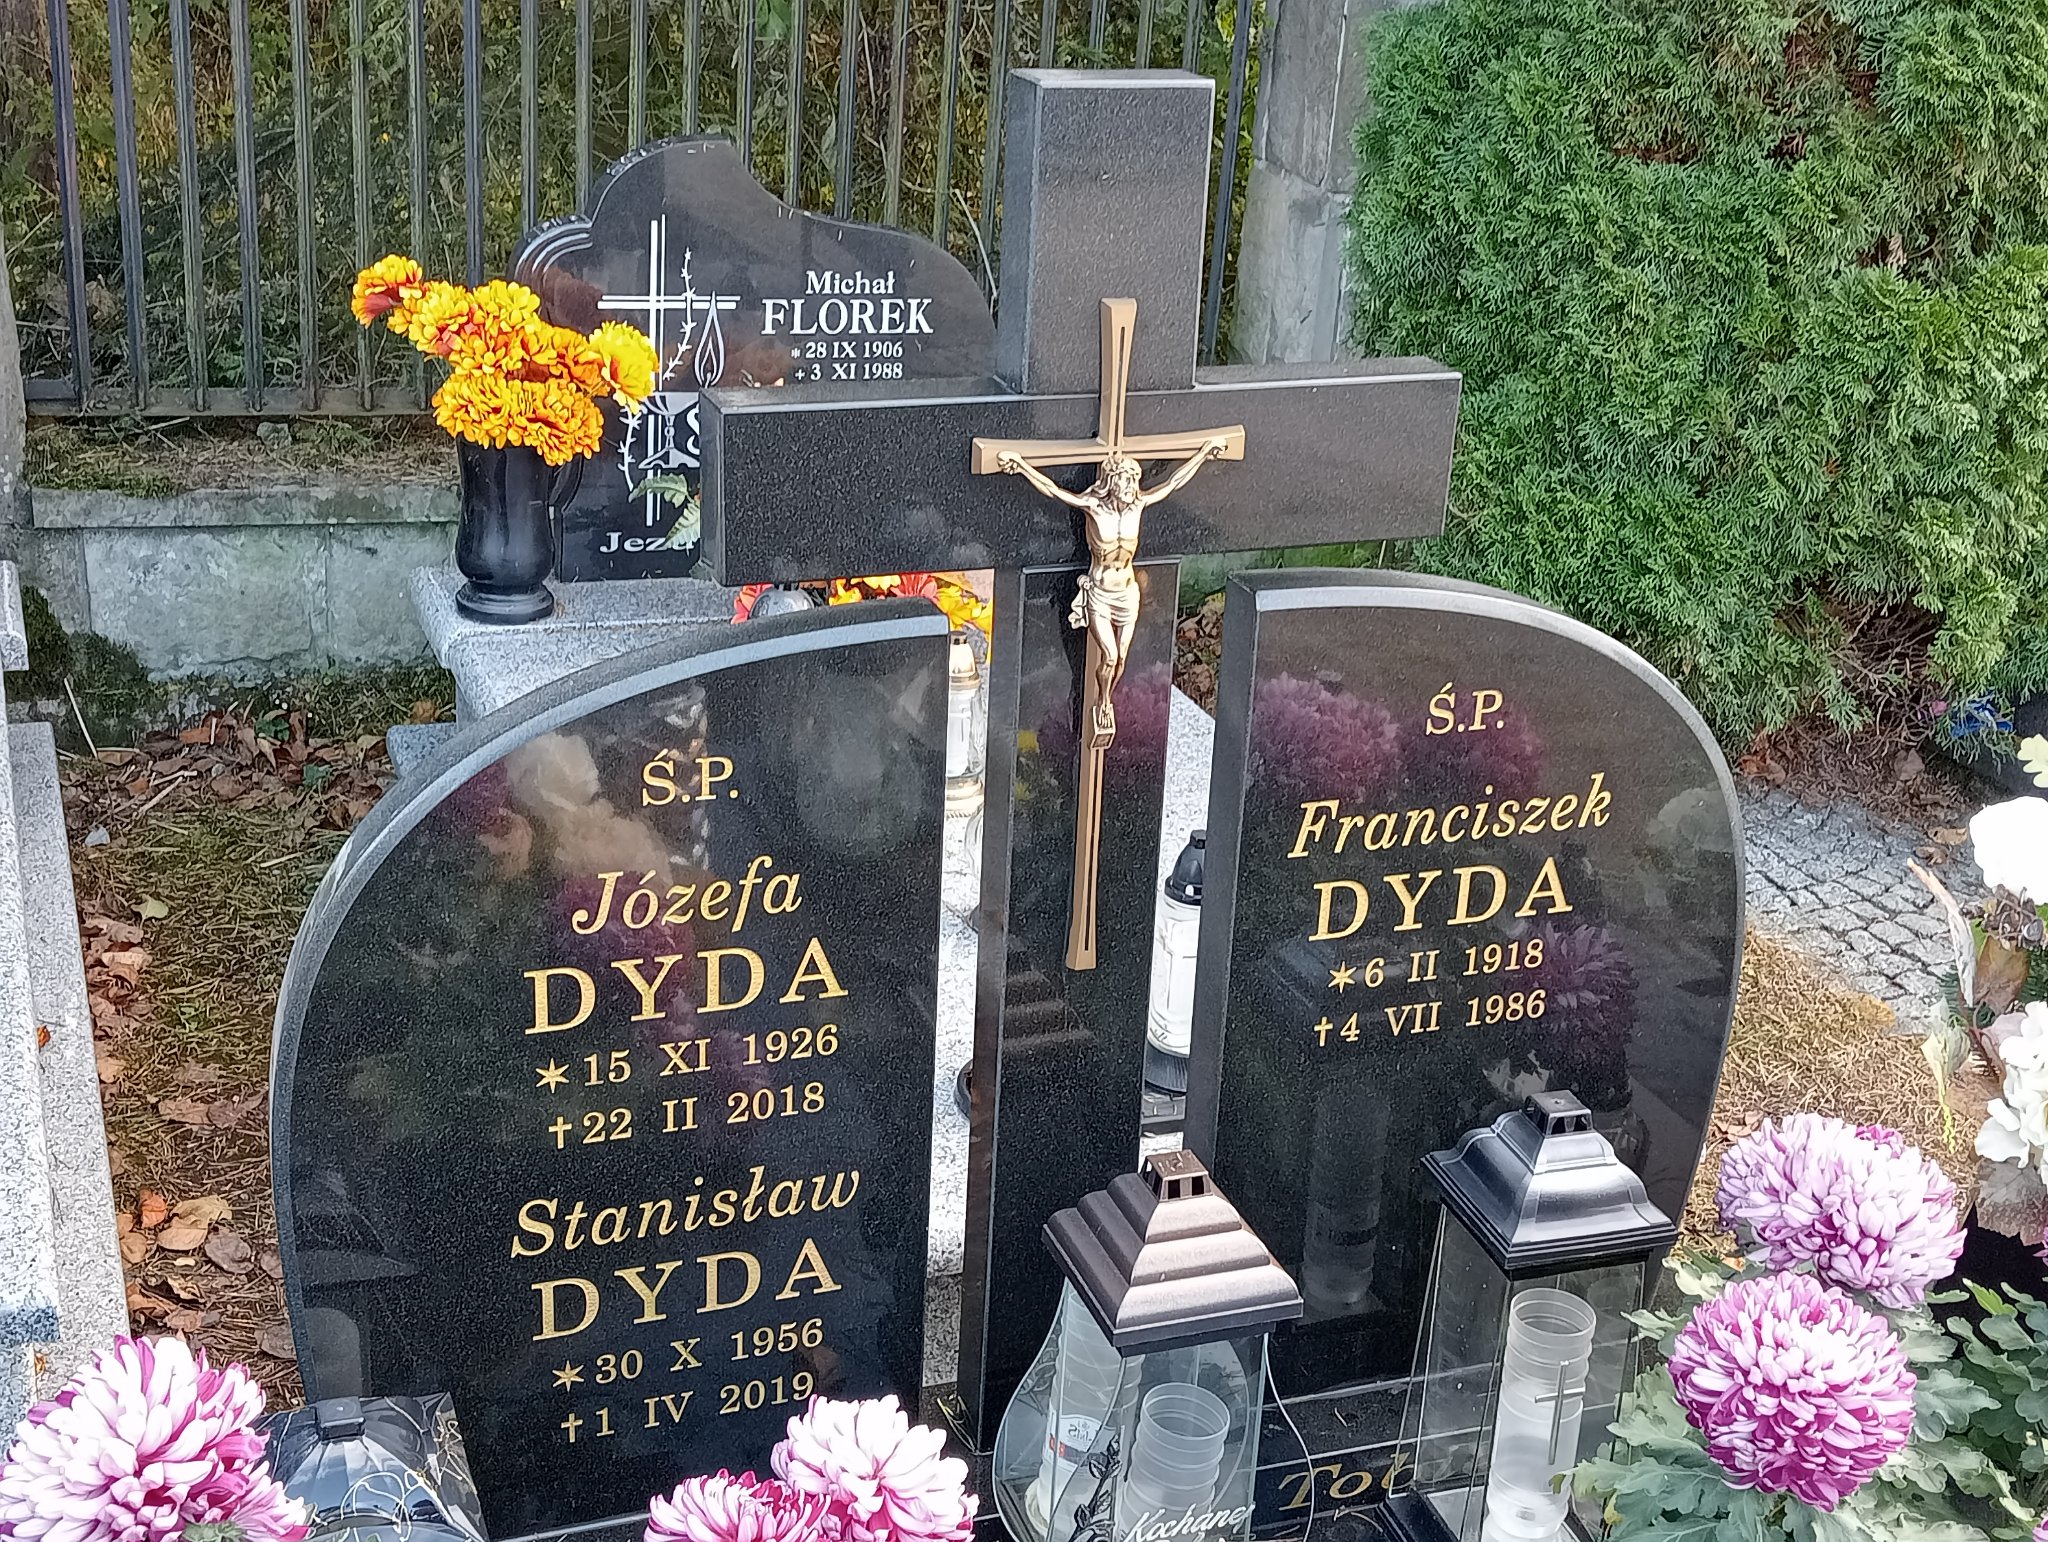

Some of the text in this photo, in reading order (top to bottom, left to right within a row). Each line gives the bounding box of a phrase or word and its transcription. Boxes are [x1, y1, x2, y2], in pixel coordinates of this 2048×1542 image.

[805, 270, 896, 295] Michał
[761, 298, 934, 335] FLOREK
[805, 340, 903, 359] 28 IX 1906
[810, 361, 903, 380] 3 XI 1988
[1425, 682, 1505, 736] Ś.P.
[641, 748, 740, 807] Ś.P.
[1287, 771, 1613, 859] Franciszek
[571, 855, 803, 935] Józefa
[1308, 856, 1573, 942] DYDA
[523, 936, 848, 1035] DYDA
[1363, 938, 1545, 988] 6 II 1918
[1339, 989, 1546, 1042] 4 VII 1986
[583, 1023, 839, 1087] 15 XI 1926
[582, 1081, 825, 1145] 22 II 2018
[510, 1165, 860, 1259] Stanisław
[531, 1237, 842, 1341] DYDA
[595, 1317, 824, 1385] 30 X 1956
[596, 1370, 815, 1438] 1 IV 2019
